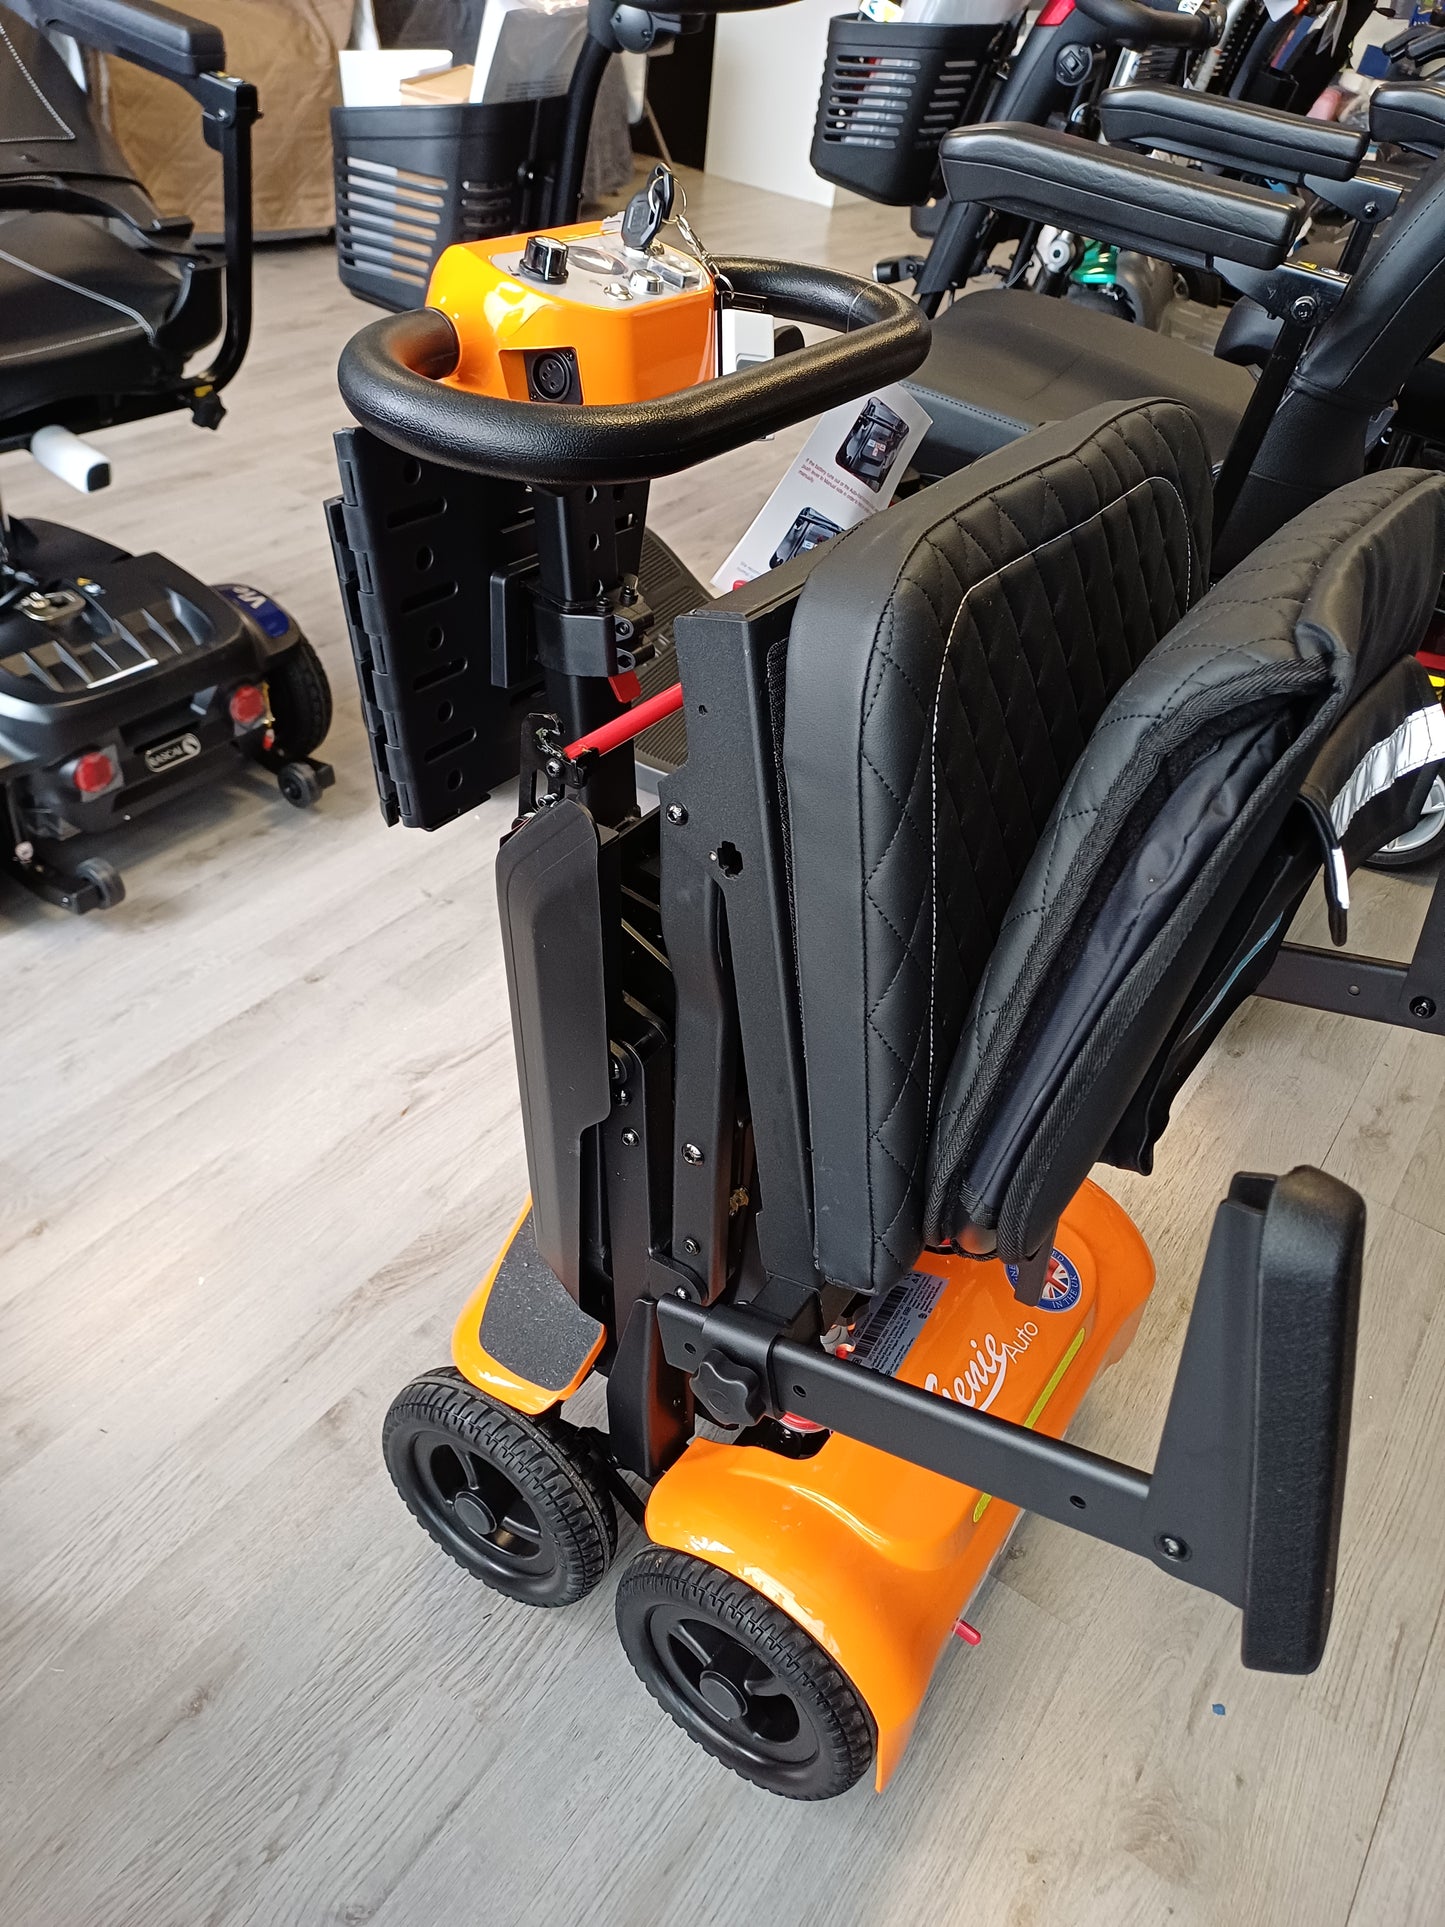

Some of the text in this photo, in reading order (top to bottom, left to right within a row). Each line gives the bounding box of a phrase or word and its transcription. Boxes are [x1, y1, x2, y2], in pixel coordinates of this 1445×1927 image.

[1051, 1273, 1079, 1308] IN THE UK
[1004, 1321, 1039, 1364] Auto
